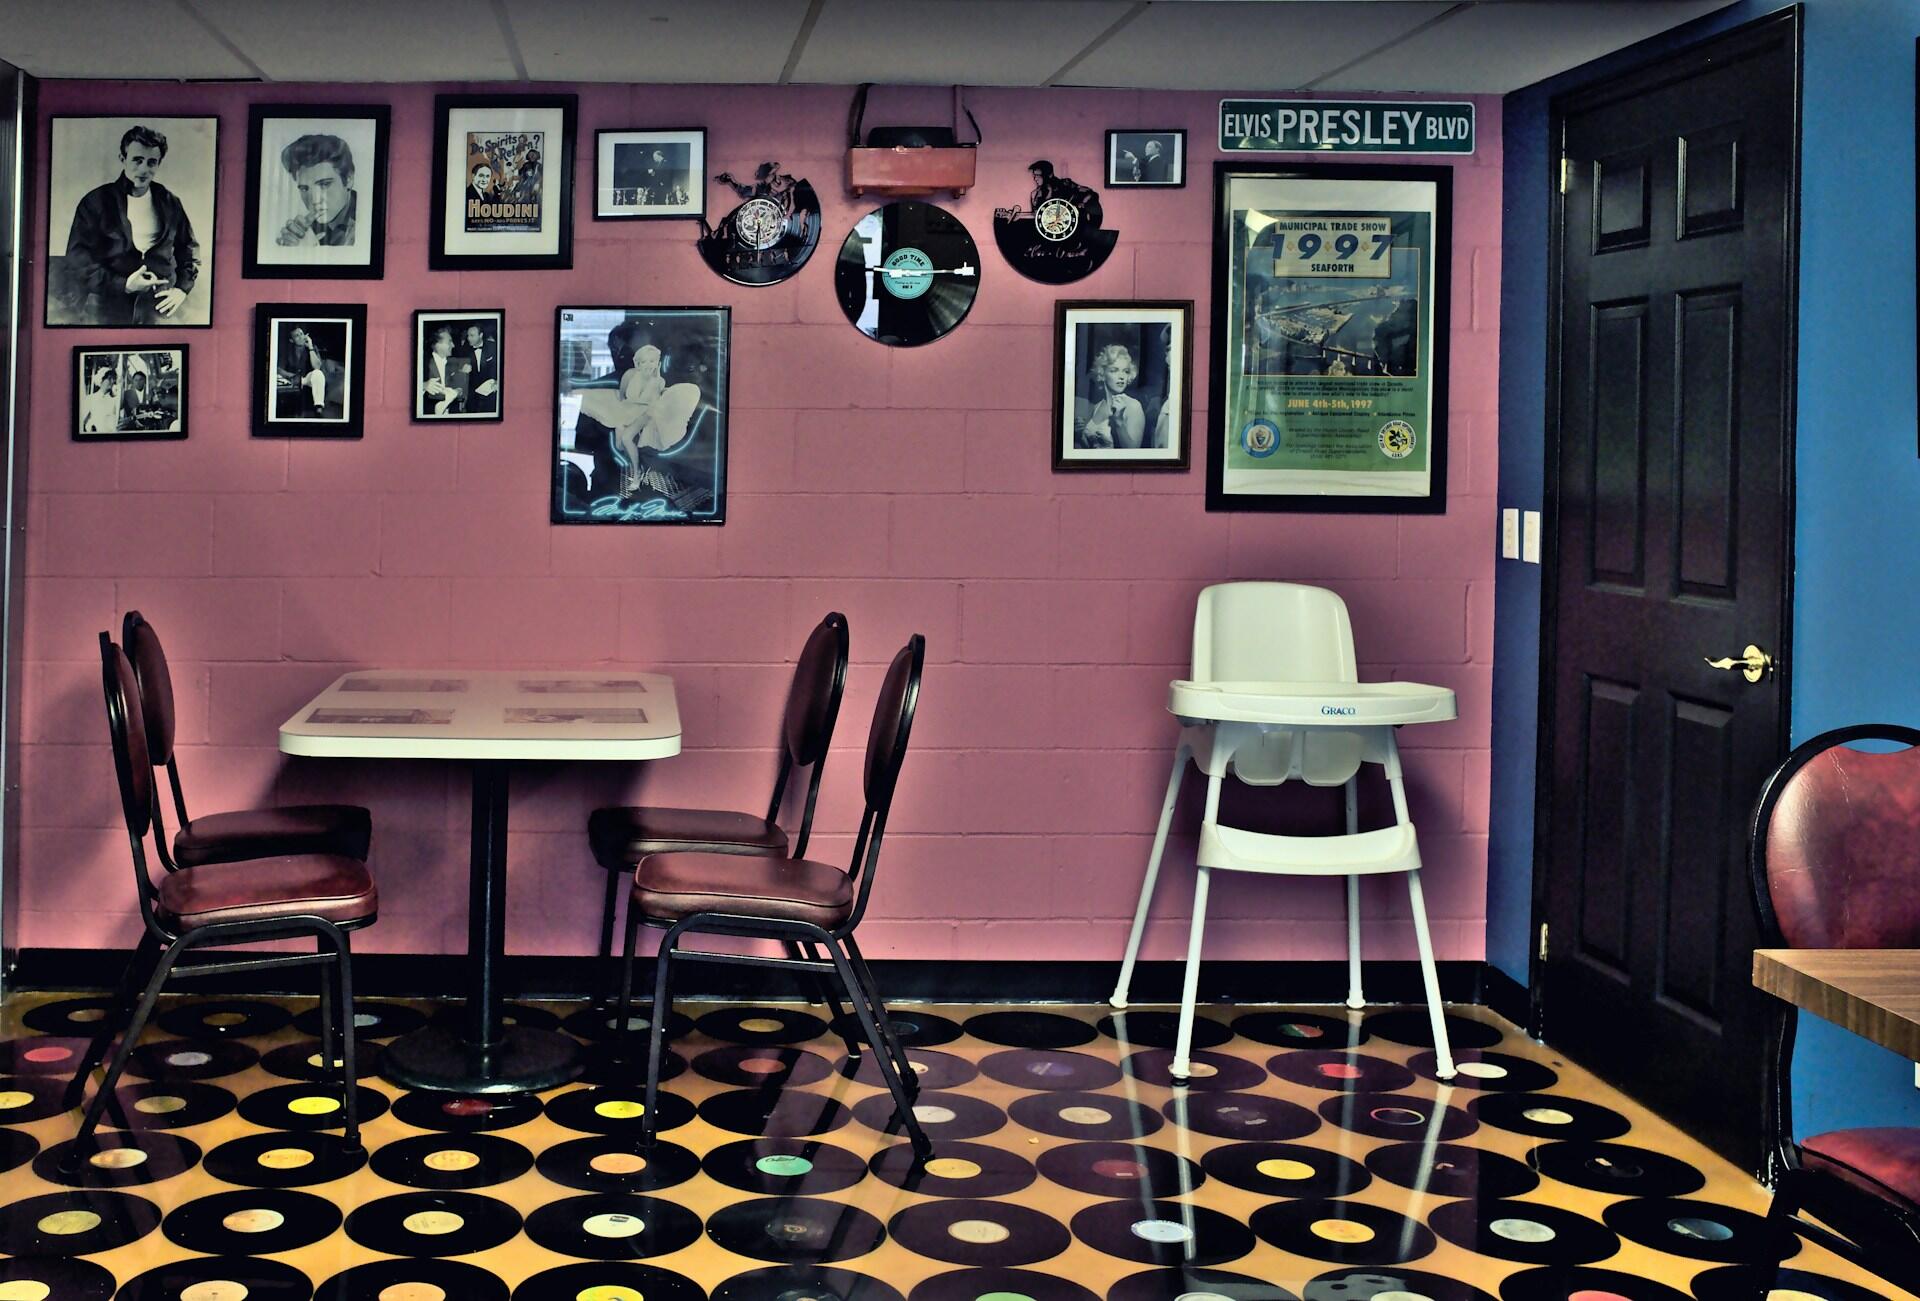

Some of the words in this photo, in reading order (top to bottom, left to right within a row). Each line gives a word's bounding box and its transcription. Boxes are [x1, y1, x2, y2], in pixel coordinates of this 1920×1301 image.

[1224, 113, 1271, 138] ELVIS
[1277, 109, 1423, 145] PRESLEY
[1426, 116, 1469, 140] BLVD
[485, 134, 517, 152] Spirits
[468, 199, 539, 218] HOUDINI
[1279, 222, 1328, 231] MUNICIPAL
[1330, 222, 1359, 231] TRADE
[1360, 222, 1387, 231] SHOW
[891, 254, 908, 266] GOOD
[910, 254, 925, 267] TIME
[1311, 263, 1355, 273] SEAFORTH
[1287, 399, 1310, 408] JUNE
[1351, 400, 1373, 409] 1997
[1321, 705, 1356, 715] GRACO
